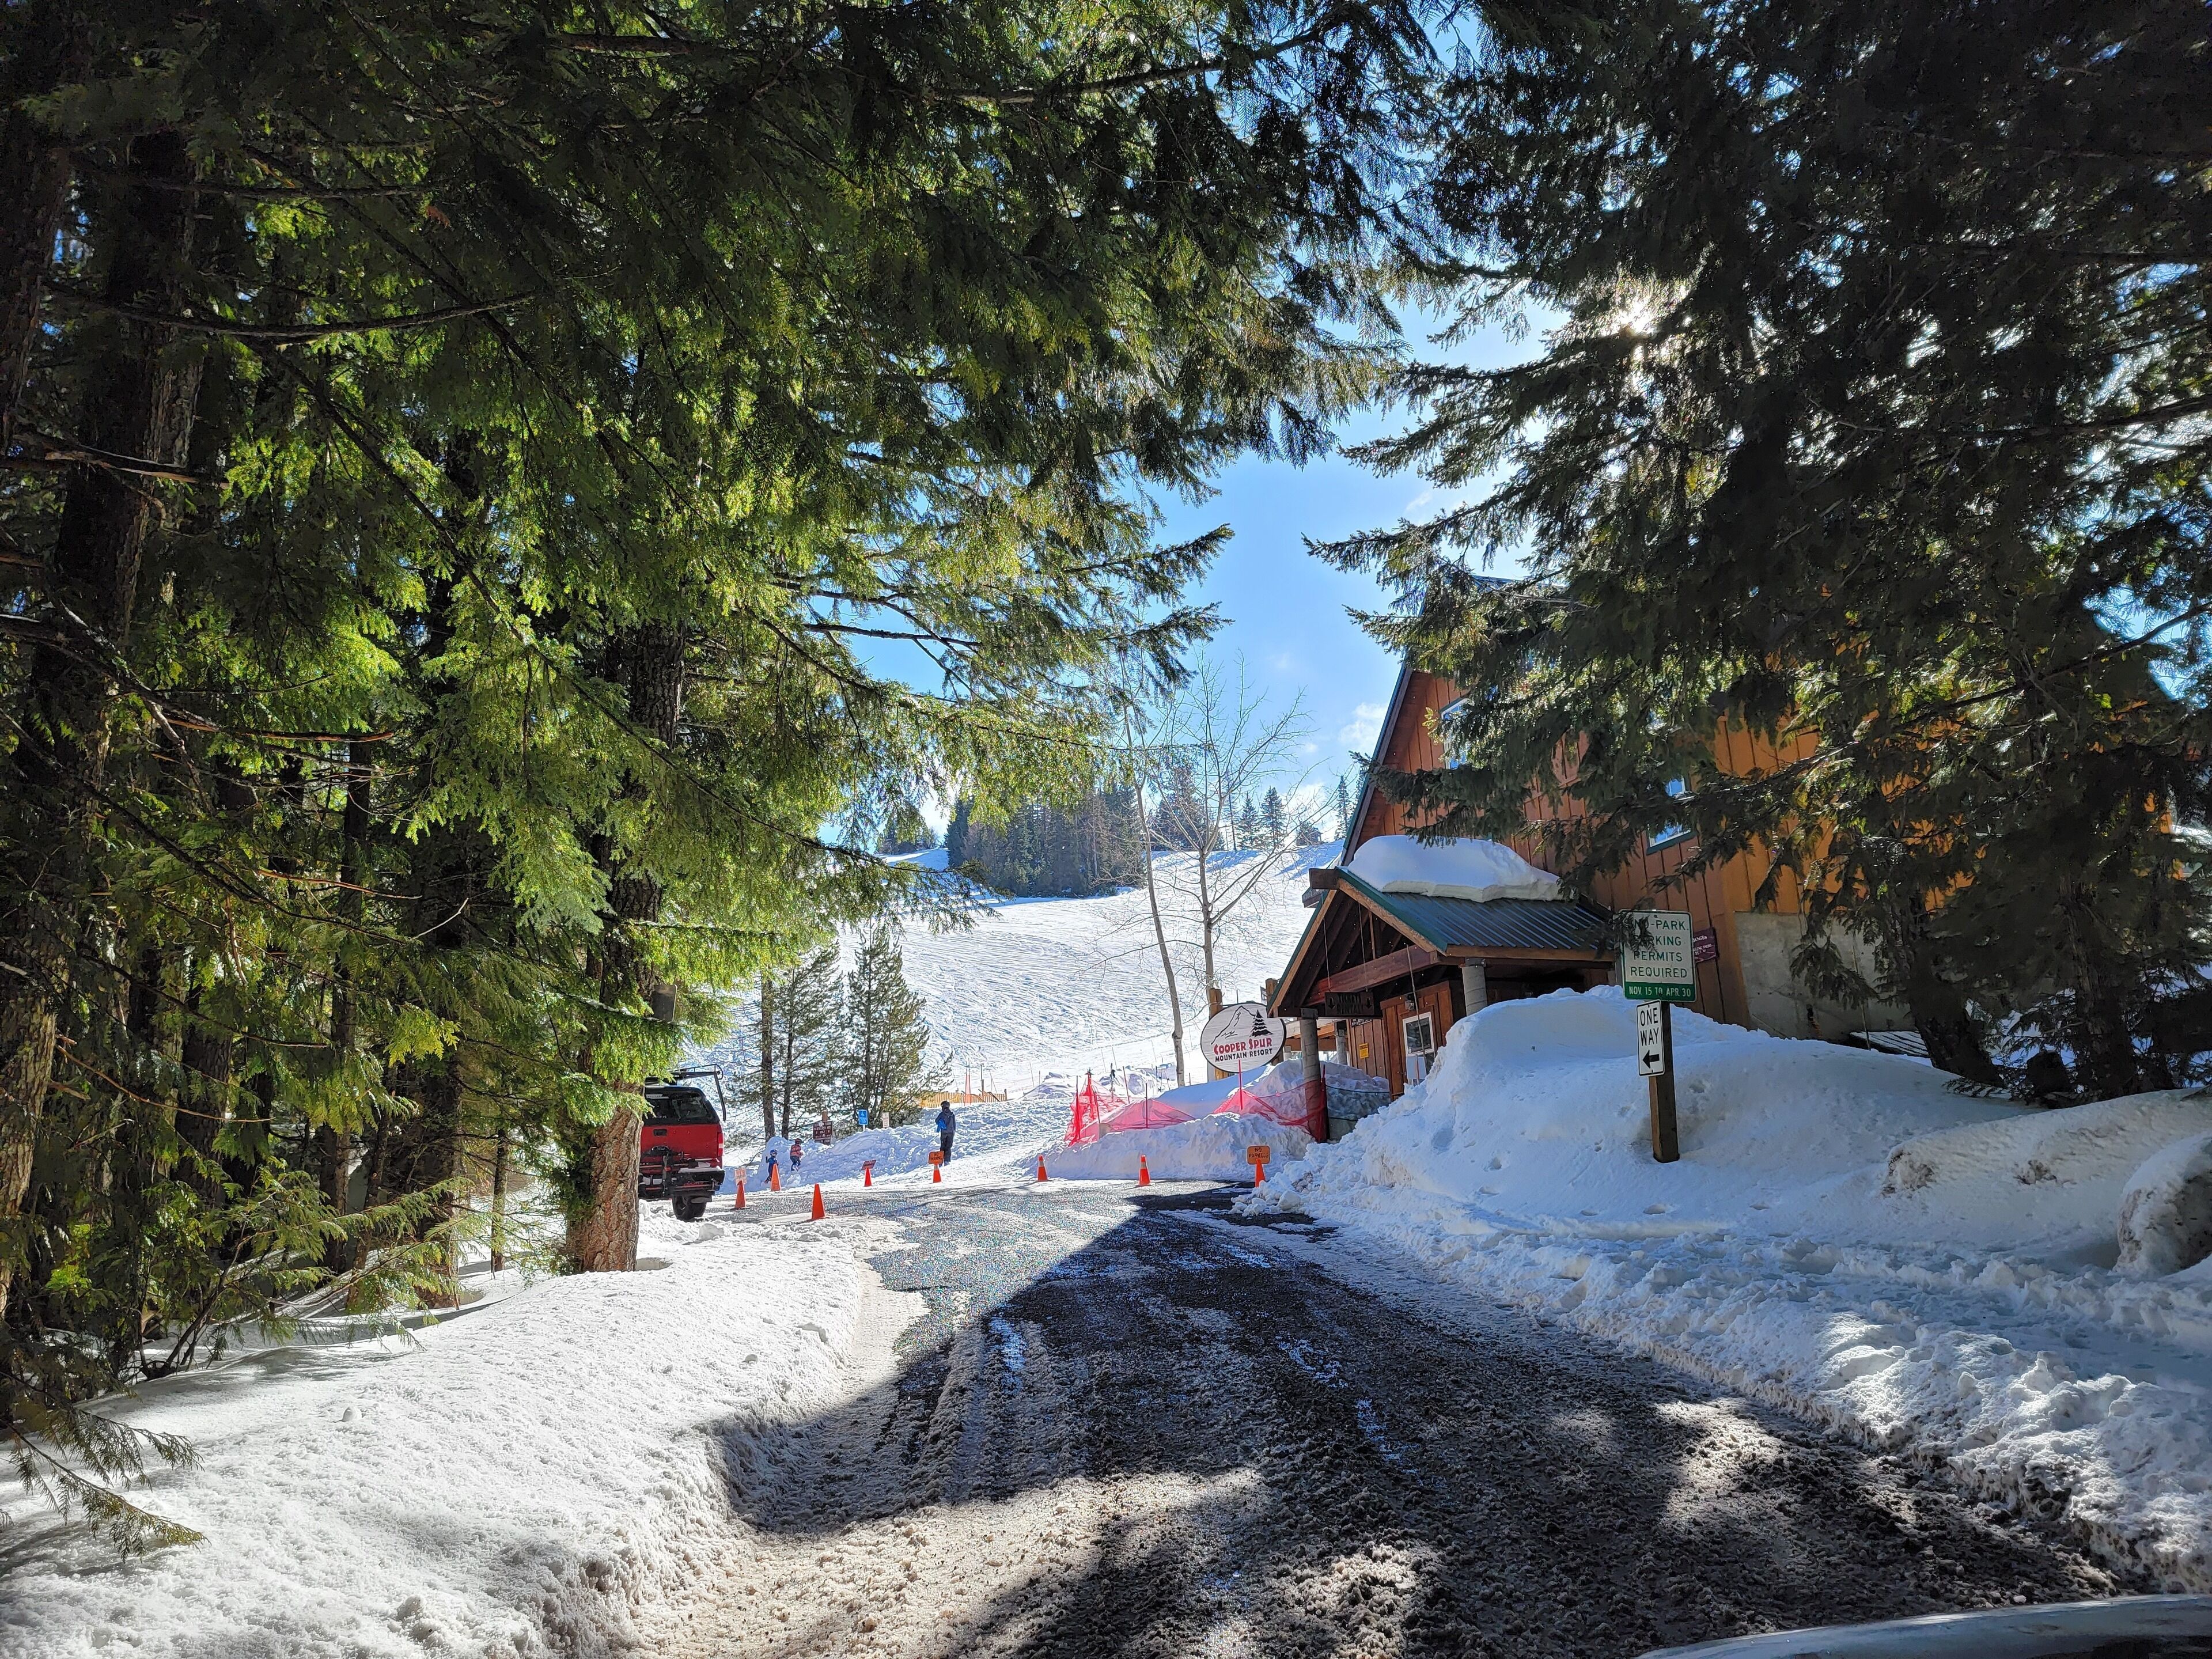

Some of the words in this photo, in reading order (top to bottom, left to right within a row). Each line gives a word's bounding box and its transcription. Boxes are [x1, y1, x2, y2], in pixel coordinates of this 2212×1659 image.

[1634, 950, 1683, 962] PERMITS
[1630, 966, 1688, 978] REQUIRED
[1645, 987, 1652, 995] 15
[1654, 987, 1663, 996] TO
[1681, 988, 1691, 997] 30
[1640, 1007, 1658, 1027] ONE
[1640, 1027, 1659, 1046] WAY
[1214, 1041, 1247, 1055] COOPER
[1248, 1037, 1272, 1050] SPUR
[1215, 1052, 1247, 1063] MOUNTAIN
[1249, 1048, 1272, 1057] RESORT
